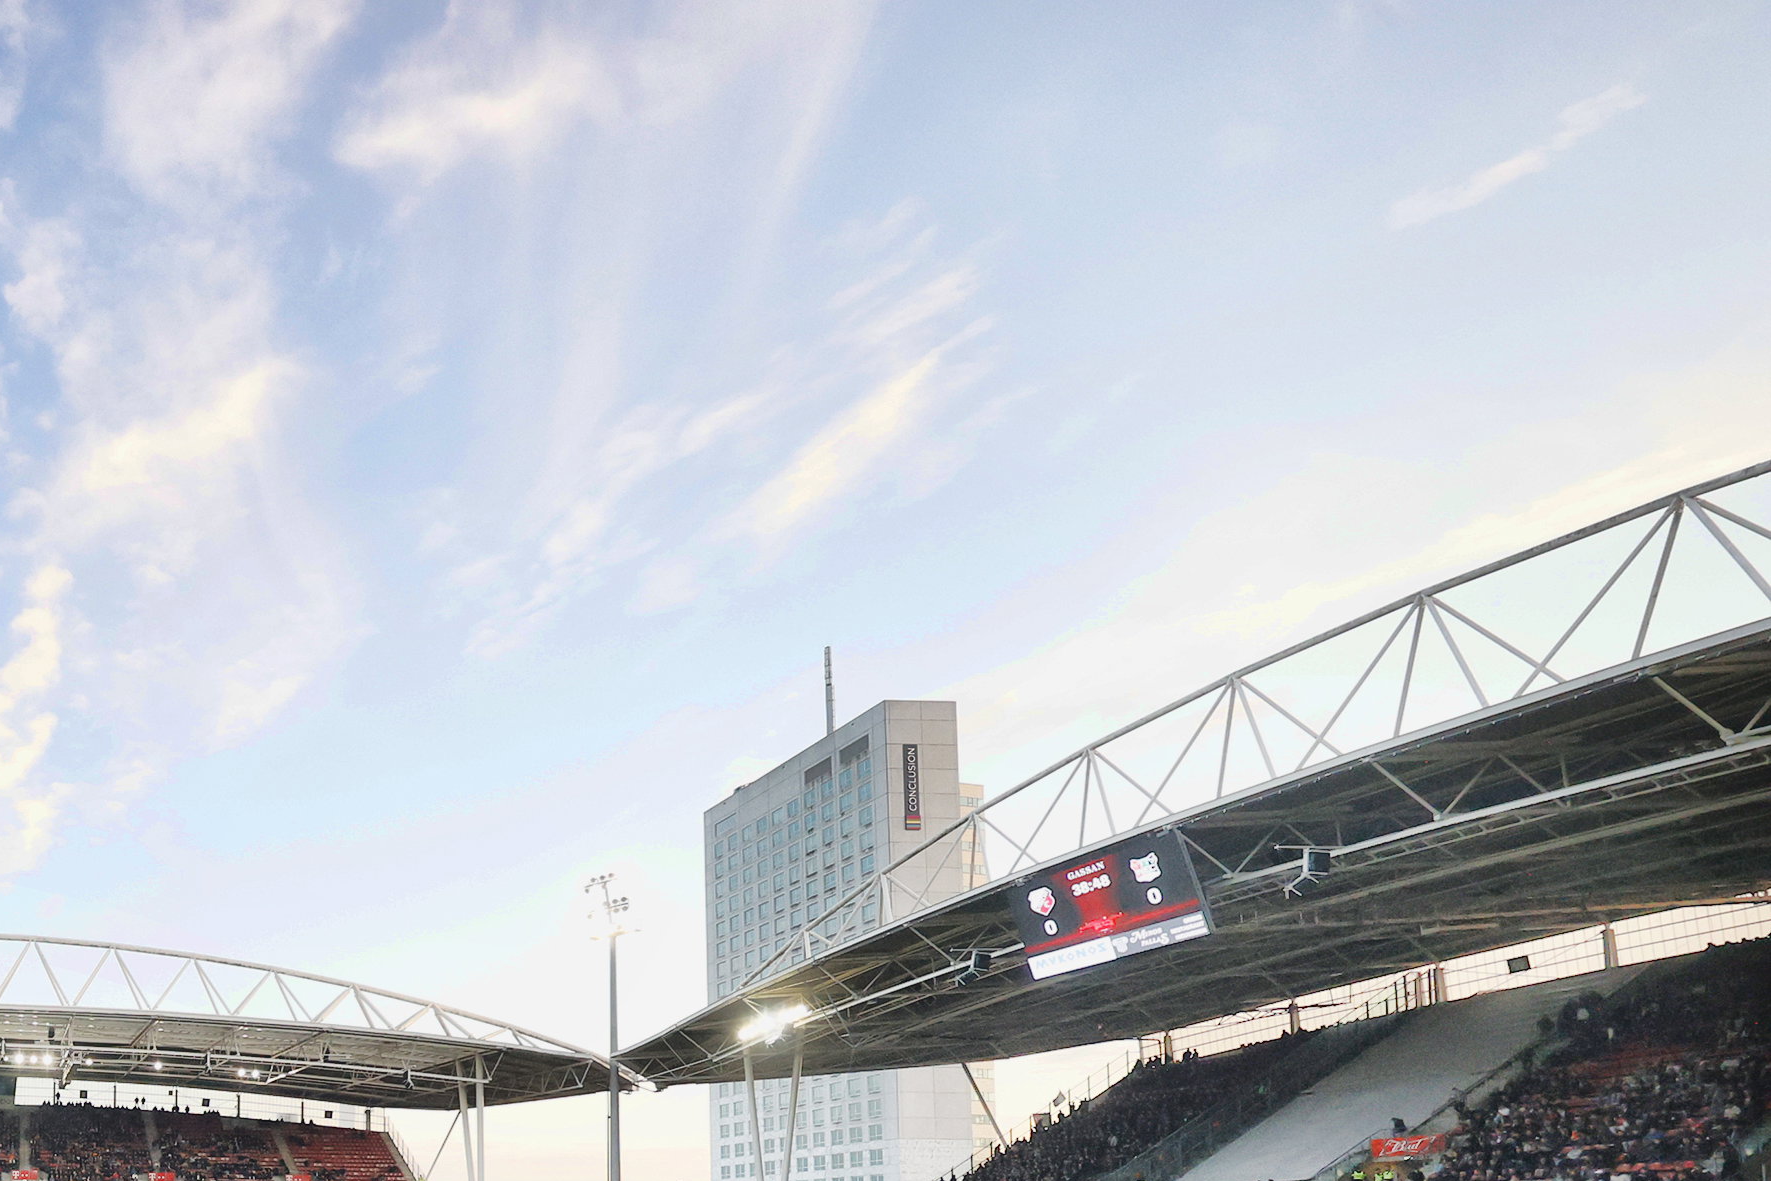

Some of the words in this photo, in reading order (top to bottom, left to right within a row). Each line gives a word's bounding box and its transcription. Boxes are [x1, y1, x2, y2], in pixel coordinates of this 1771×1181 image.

[908, 747, 917, 812] CONCLUSION
[1066, 861, 1105, 881] GASSAN
[1147, 887, 1163, 905] 0
[1044, 919, 1058, 936] 0
[1036, 943, 1108, 969] MYKONOS
